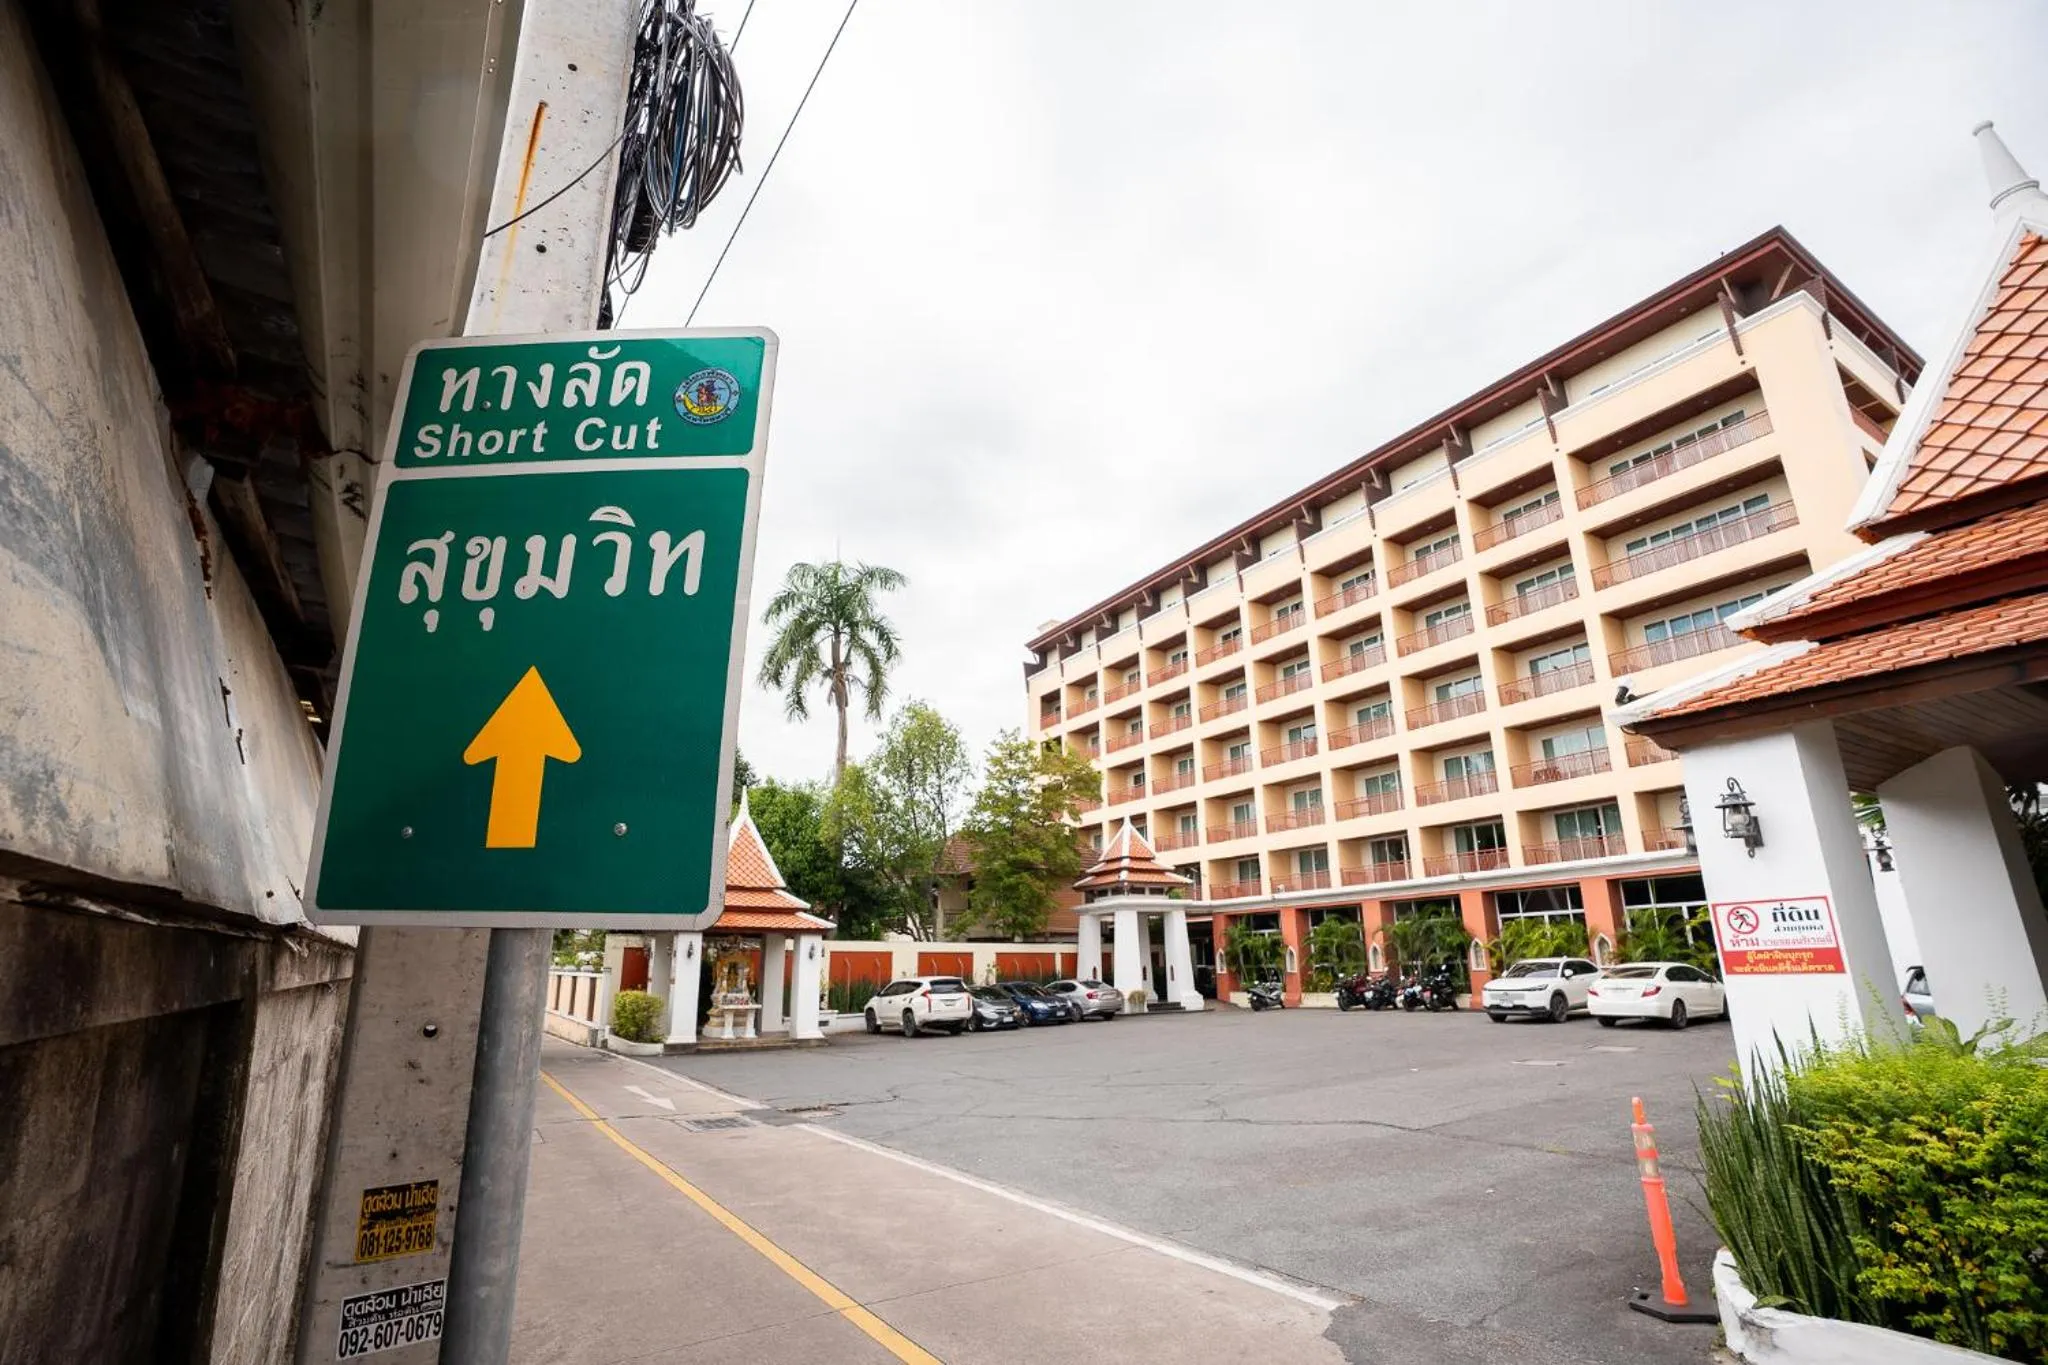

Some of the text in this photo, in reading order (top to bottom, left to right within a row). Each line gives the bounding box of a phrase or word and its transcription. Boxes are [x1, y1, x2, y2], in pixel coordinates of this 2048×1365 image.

[439, 344, 652, 413] ทางลัด
[413, 421, 549, 458] Short
[574, 416, 662, 451] Cut
[398, 505, 706, 632] สุขุมวิท
[1772, 903, 1820, 922] ที่ดิน
[1729, 935, 1759, 947] ห้าม
[339, 1311, 443, 1358] 092-607-0679
